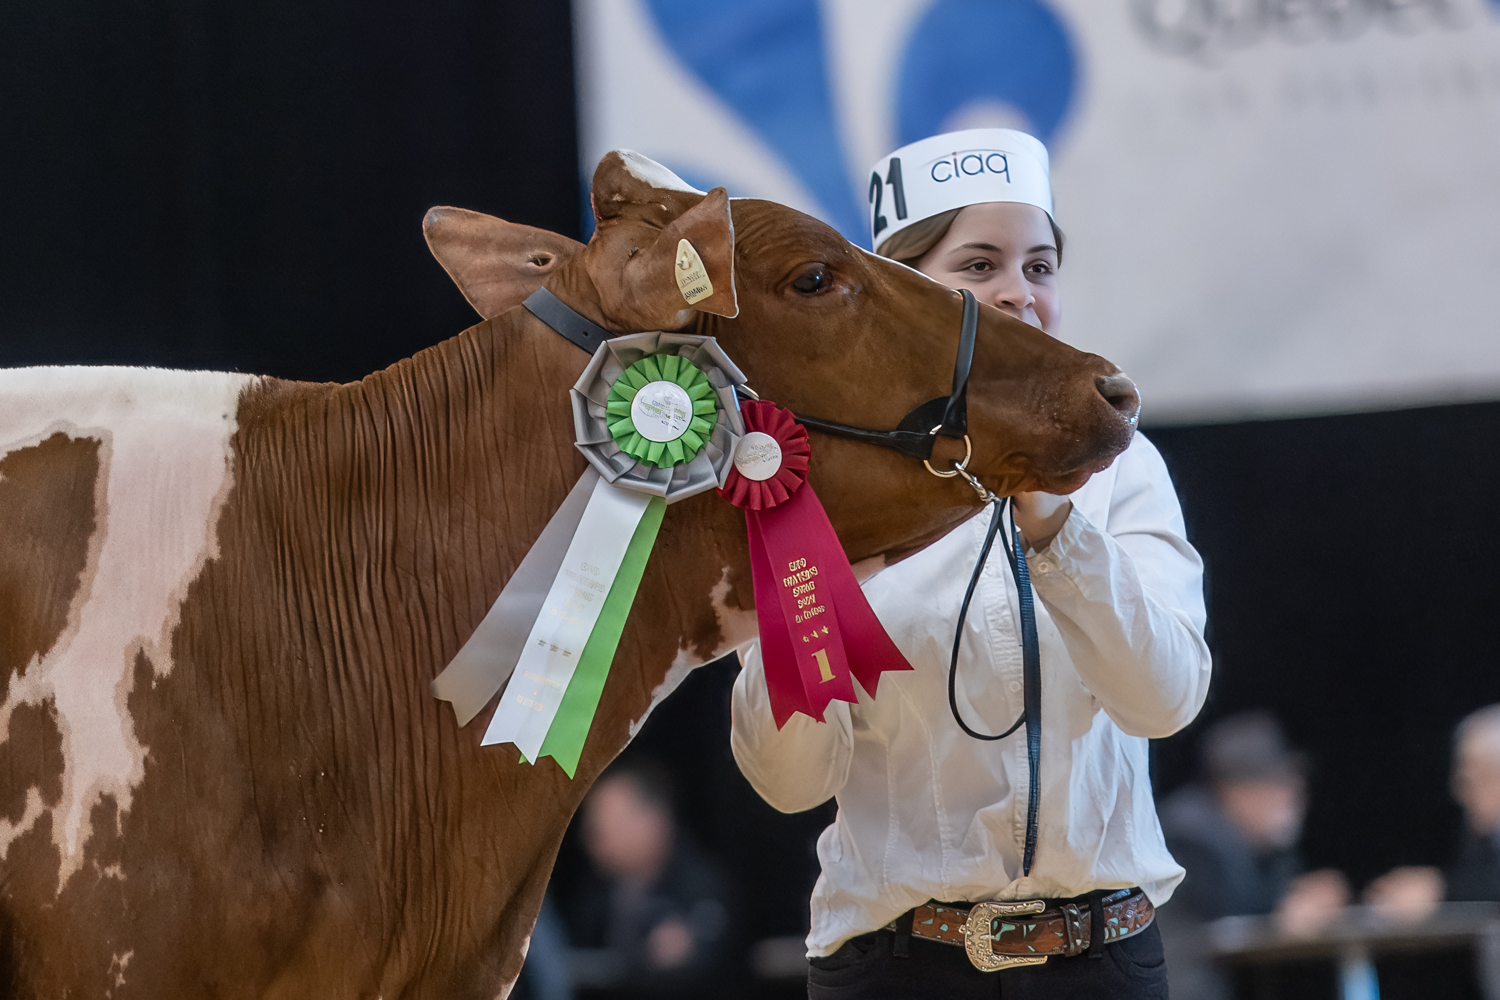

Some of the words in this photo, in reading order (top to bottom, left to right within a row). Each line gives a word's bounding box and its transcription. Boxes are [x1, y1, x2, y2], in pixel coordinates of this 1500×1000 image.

[930, 151, 1011, 184] ciaq
[868, 157, 908, 239] 21
[811, 647, 836, 684] 1
